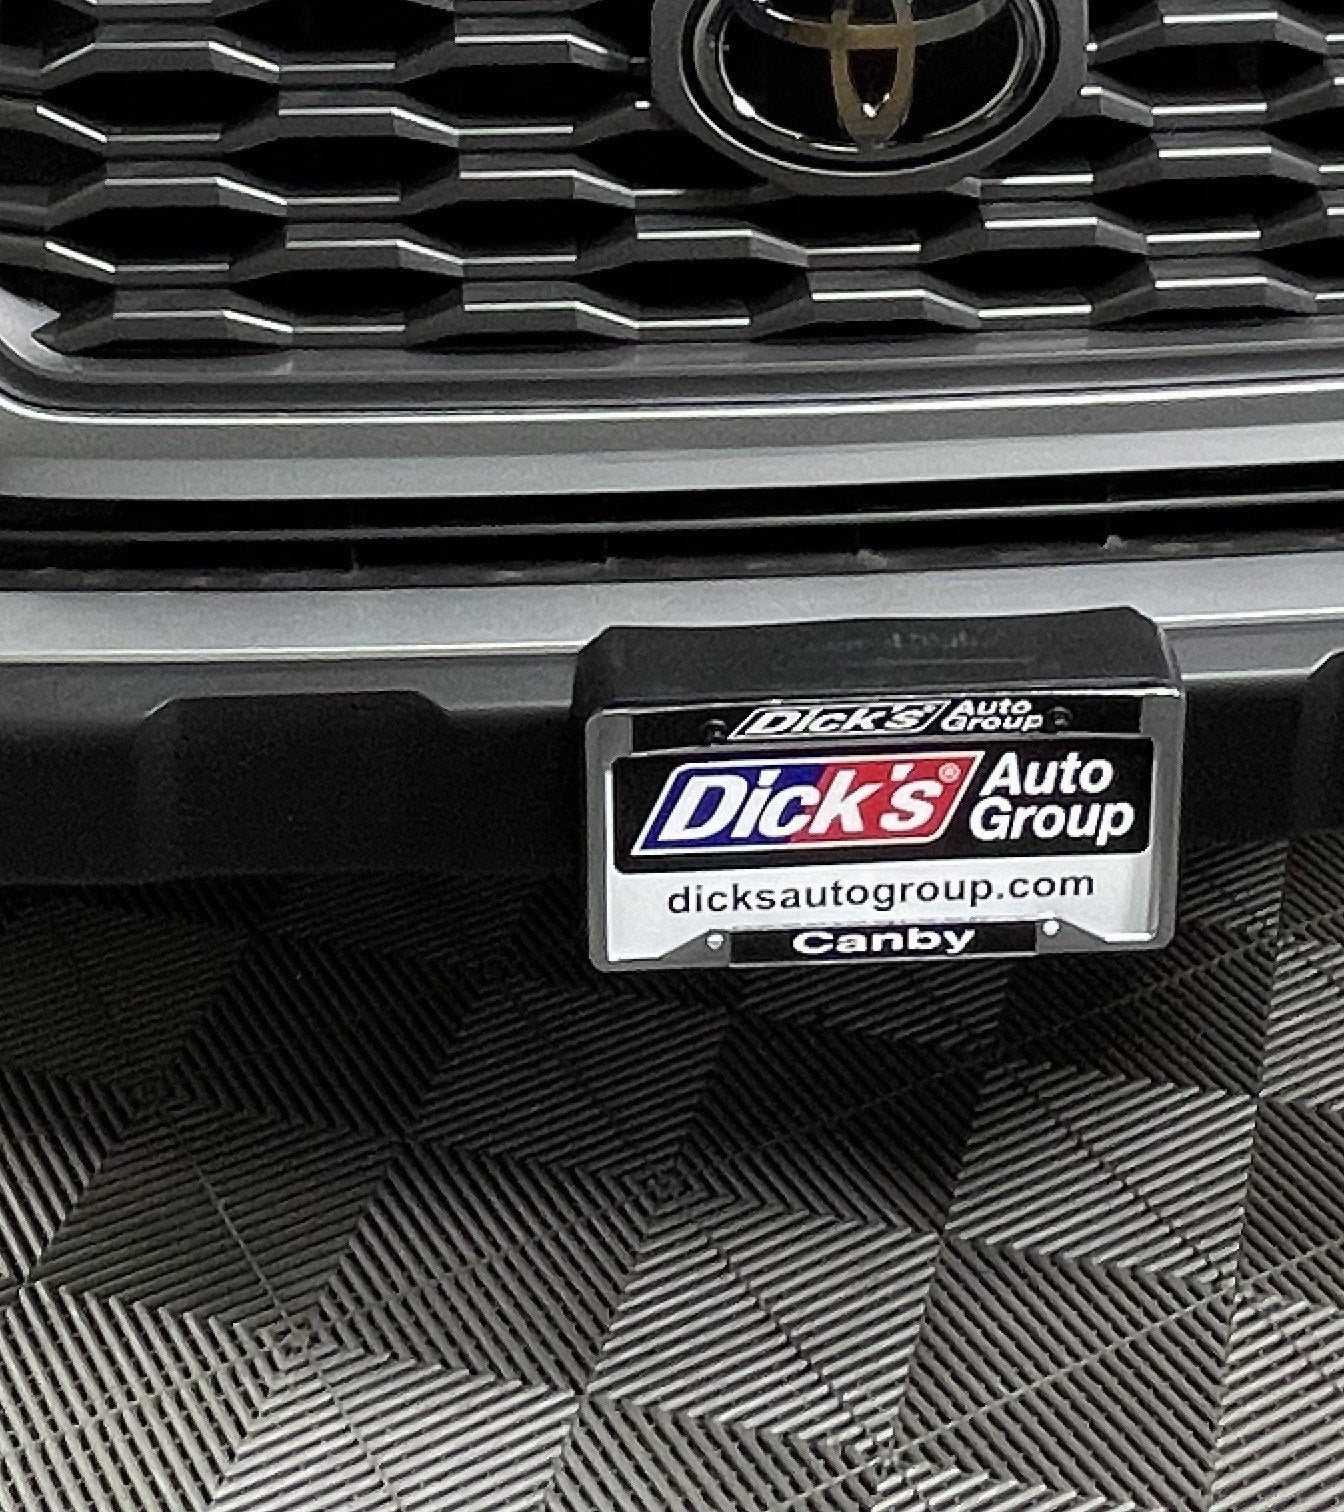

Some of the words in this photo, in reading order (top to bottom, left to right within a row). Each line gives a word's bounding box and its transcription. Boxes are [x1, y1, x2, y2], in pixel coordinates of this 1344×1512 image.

[940, 714, 1044, 732] Group
[953, 698, 1032, 716] Auto
[979, 752, 1113, 796] Auto
[969, 797, 1135, 846] Group
[667, 875, 1094, 914] dicksautogroup.com
[792, 926, 975, 954] Canby
